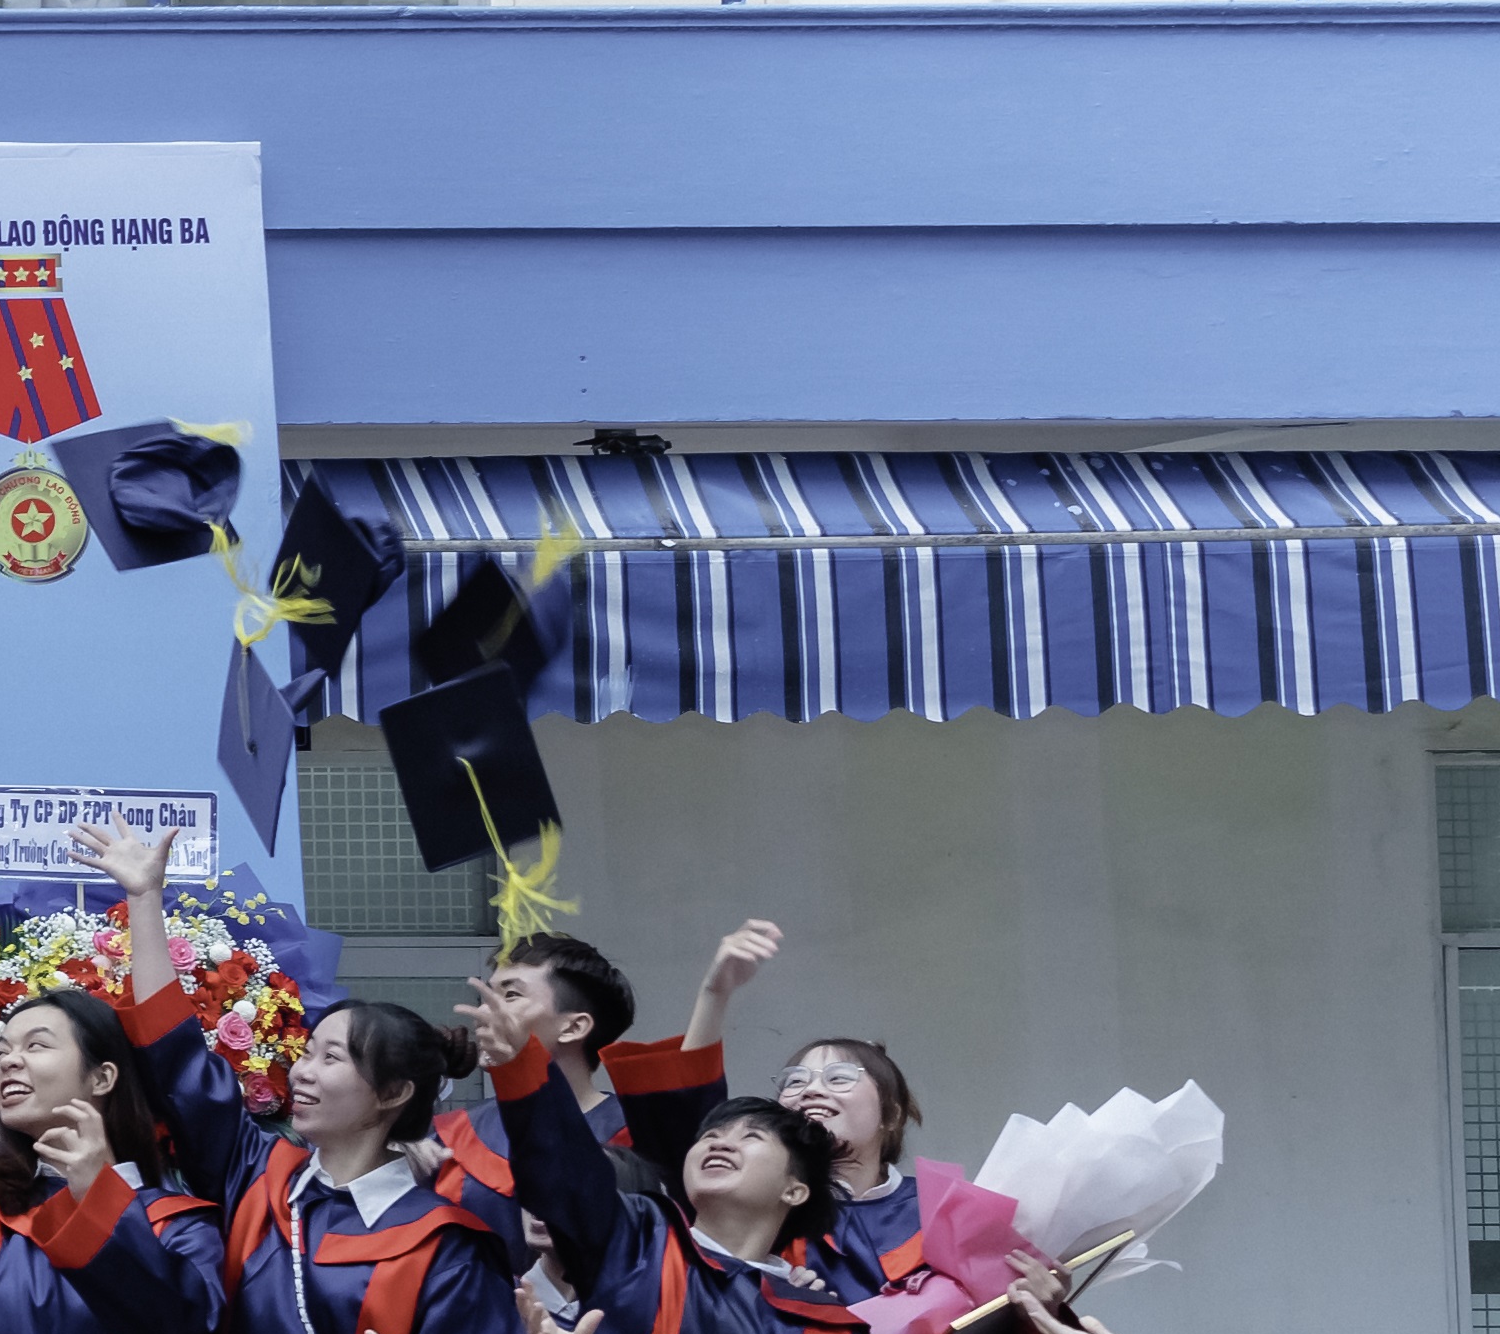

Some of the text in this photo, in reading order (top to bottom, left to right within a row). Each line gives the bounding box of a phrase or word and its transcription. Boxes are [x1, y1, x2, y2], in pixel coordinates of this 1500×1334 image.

[43, 214, 105, 252] ĐỘNG
[112, 217, 173, 251] HẠNG
[180, 217, 211, 244] BA
[45, 478, 65, 495] LAO
[10, 799, 29, 828] Ty
[34, 800, 54, 823] CP
[82, 801, 112, 825] FPT
[158, 802, 196, 828] Châu
[51, 839, 68, 865] Cao
